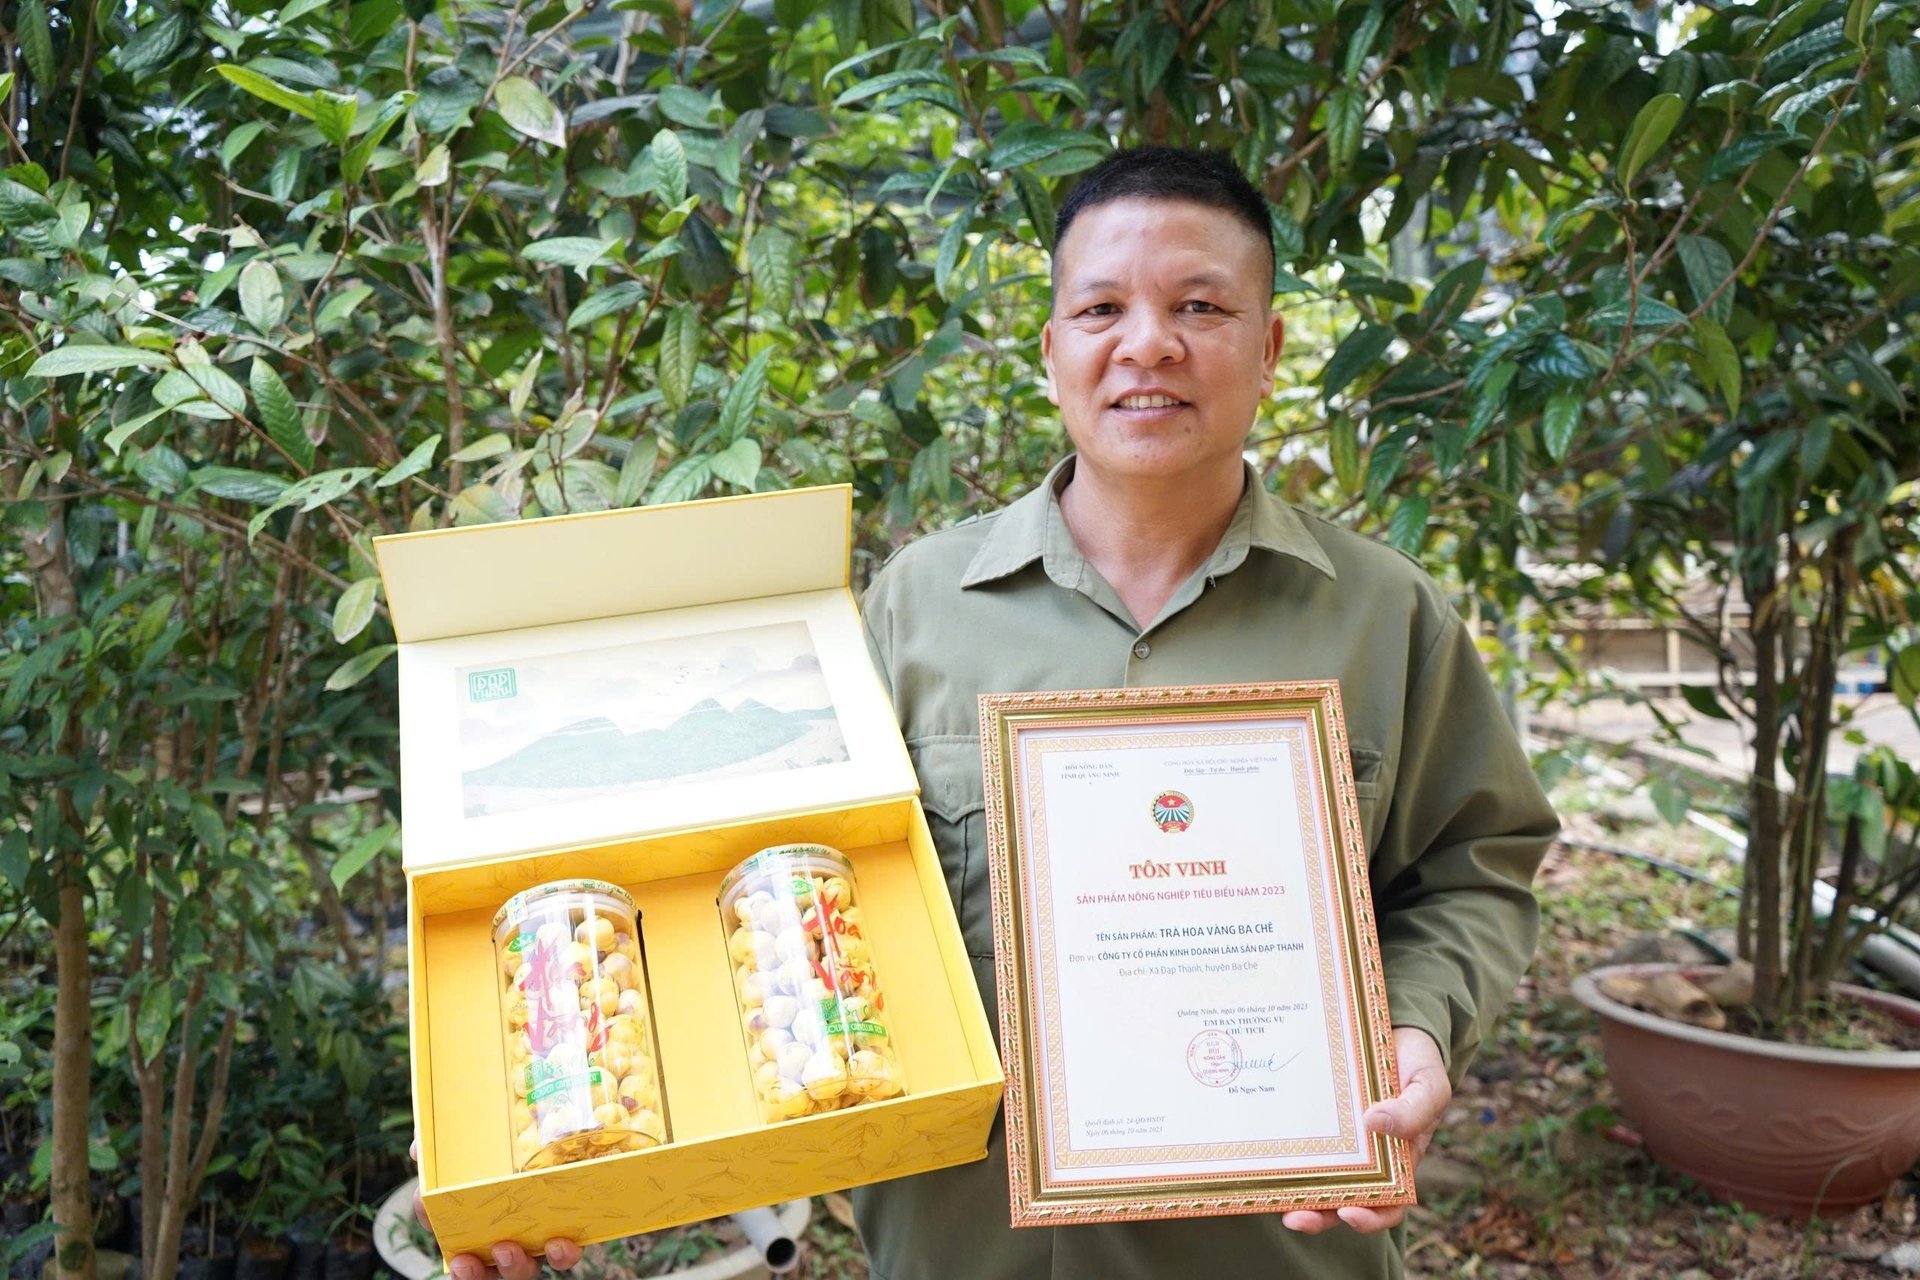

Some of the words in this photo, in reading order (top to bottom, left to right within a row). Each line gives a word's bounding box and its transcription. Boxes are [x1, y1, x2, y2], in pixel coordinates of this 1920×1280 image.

[1128, 859, 1170, 879] TÔN
[1174, 860, 1227, 877] VINH
[1076, 892, 1096, 904] SẢN
[1097, 890, 1126, 903] PHẨM
[1128, 891, 1155, 901] NÔNG
[1157, 888, 1190, 900] NGHIỆP
[1193, 888, 1212, 898] TIÊU
[1214, 886, 1234, 898] BIỂU
[1237, 886, 1260, 896] NĂM
[1262, 886, 1285, 895] 2023
[1096, 931, 1111, 941] TÊN
[1112, 931, 1129, 940] SẢN
[1131, 928, 1158, 939] PHẨM:
[1160, 925, 1180, 938] TRÀ
[1182, 927, 1204, 936] HOA
[1206, 924, 1236, 935] VÀNG
[1238, 925, 1253, 934] BA
[1098, 951, 1120, 960] CÔNG
[1133, 948, 1143, 958] CỔ
[1146, 948, 1168, 958] PHẦN
[1170, 948, 1189, 957] KINH
[1191, 947, 1219, 956] DOANH
[1221, 945, 1239, 954] LÂM
[1240, 944, 1257, 953] SẢN
[1259, 943, 1275, 954] ĐẠP
[1277, 943, 1304, 951] THANH
